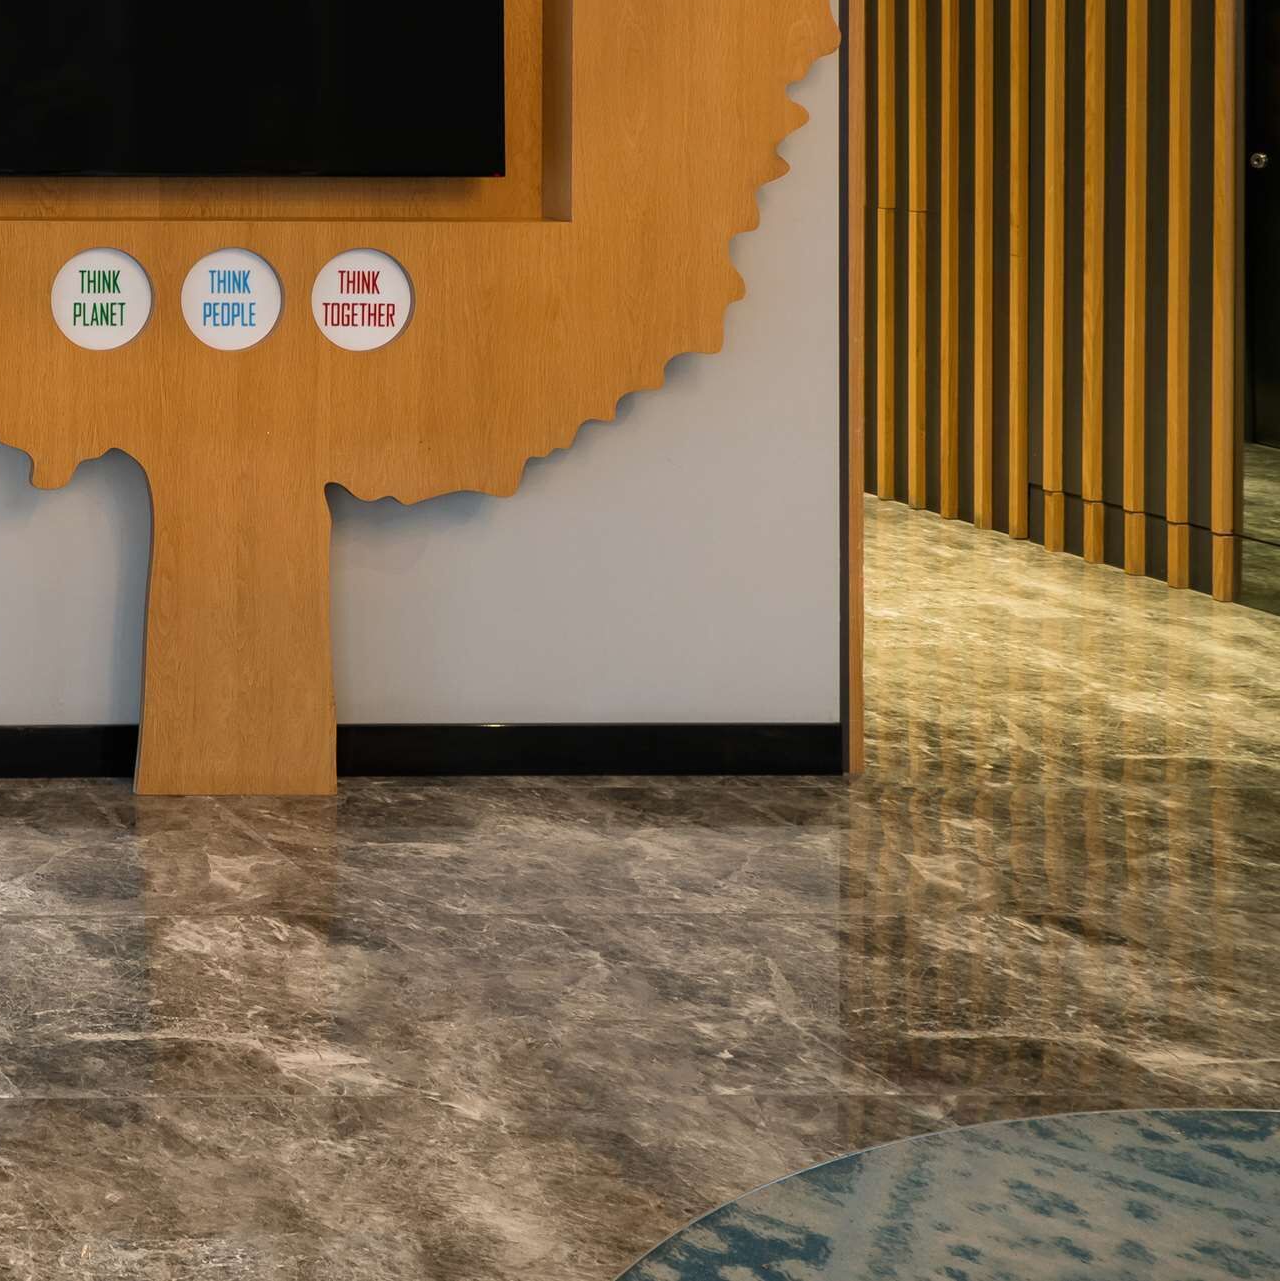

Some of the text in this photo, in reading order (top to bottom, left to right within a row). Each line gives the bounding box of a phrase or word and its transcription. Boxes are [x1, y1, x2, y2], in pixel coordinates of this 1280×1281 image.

[79, 270, 121, 295] THINK
[208, 270, 251, 295] THINK
[338, 270, 380, 295] THINK
[73, 302, 126, 327] PLANET
[203, 302, 256, 327] PEOPLE
[322, 302, 396, 328] TOGETHER
